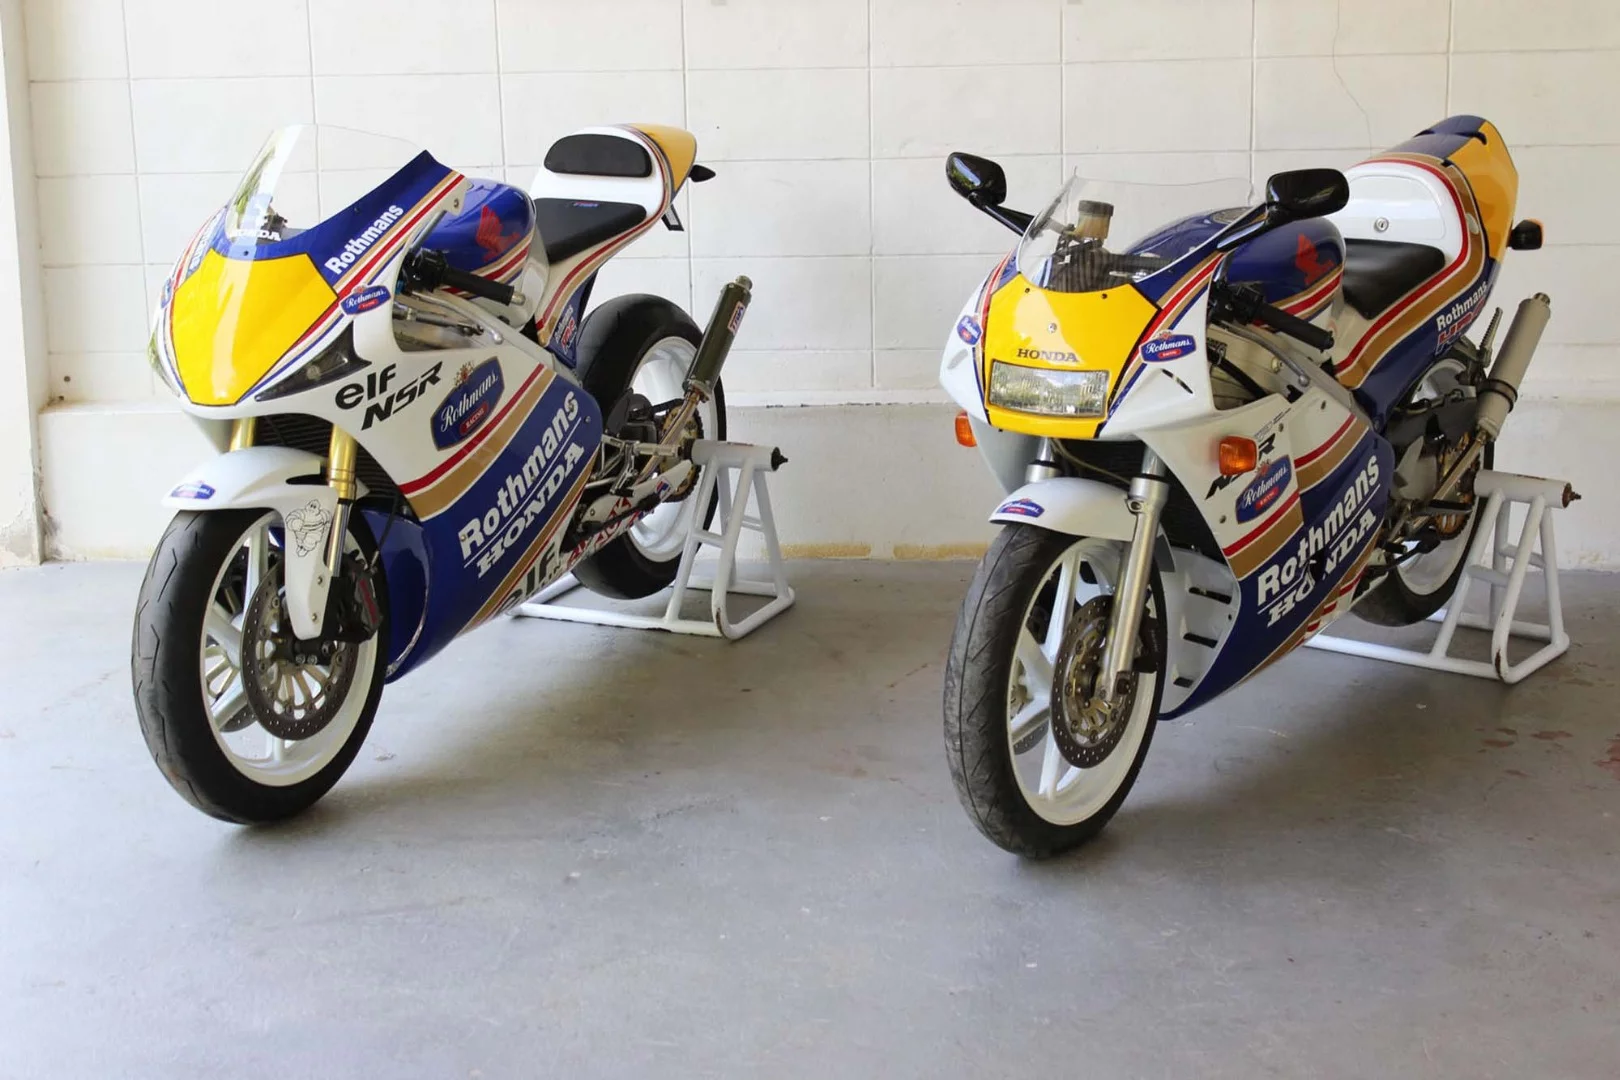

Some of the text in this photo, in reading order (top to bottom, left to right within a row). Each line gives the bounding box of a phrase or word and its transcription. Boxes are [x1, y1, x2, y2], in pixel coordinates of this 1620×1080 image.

[325, 203, 404, 276] Rothmans
[1436, 281, 1488, 331] Rothmans
[1016, 348, 1079, 363] HONDA
[1145, 338, 1193, 355] Rothmans
[335, 363, 396, 410] elf
[361, 361, 443, 431] NSR
[440, 370, 499, 433] Rothmans
[458, 391, 578, 560] Rothmans
[1205, 432, 1276, 500] NR
[1241, 463, 1288, 509] Rothmans
[478, 442, 585, 579] HONDA
[1258, 455, 1380, 606] Rothmans
